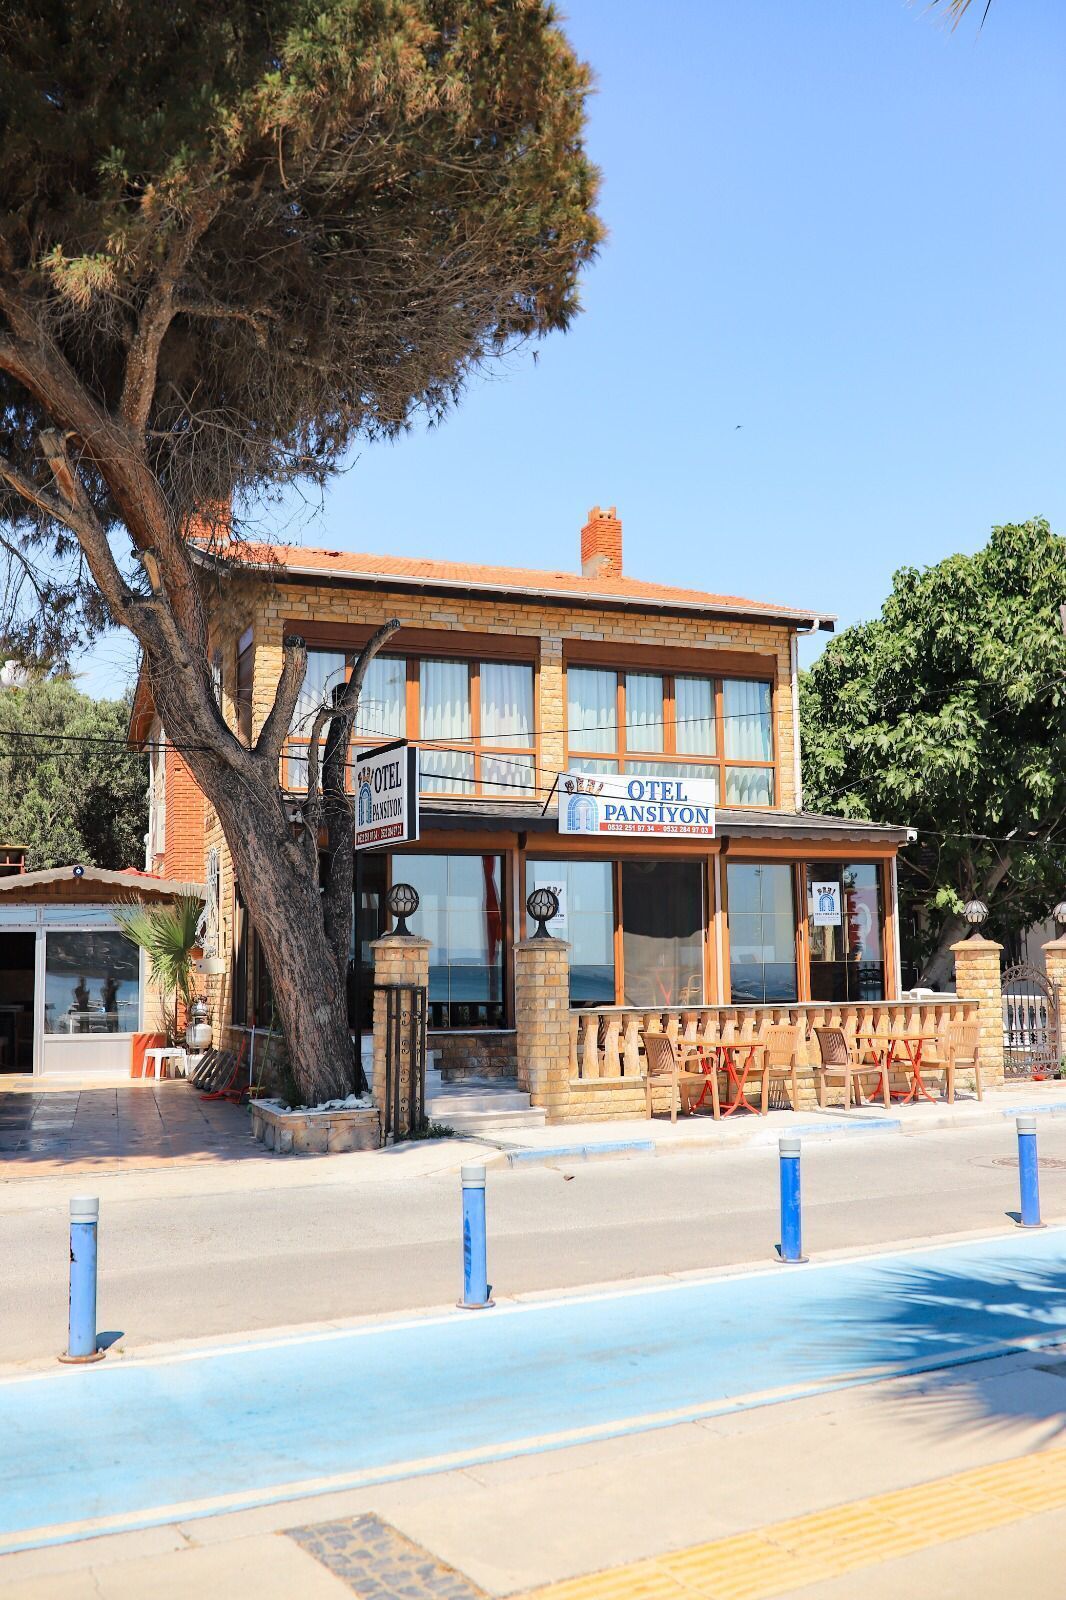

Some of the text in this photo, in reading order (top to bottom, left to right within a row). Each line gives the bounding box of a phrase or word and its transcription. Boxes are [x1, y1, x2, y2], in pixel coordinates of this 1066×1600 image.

[375, 761, 402, 793] OTEL
[627, 780, 688, 801] OTEL
[604, 802, 710, 824] PANSİYON
[662, 825, 678, 833] 0532
